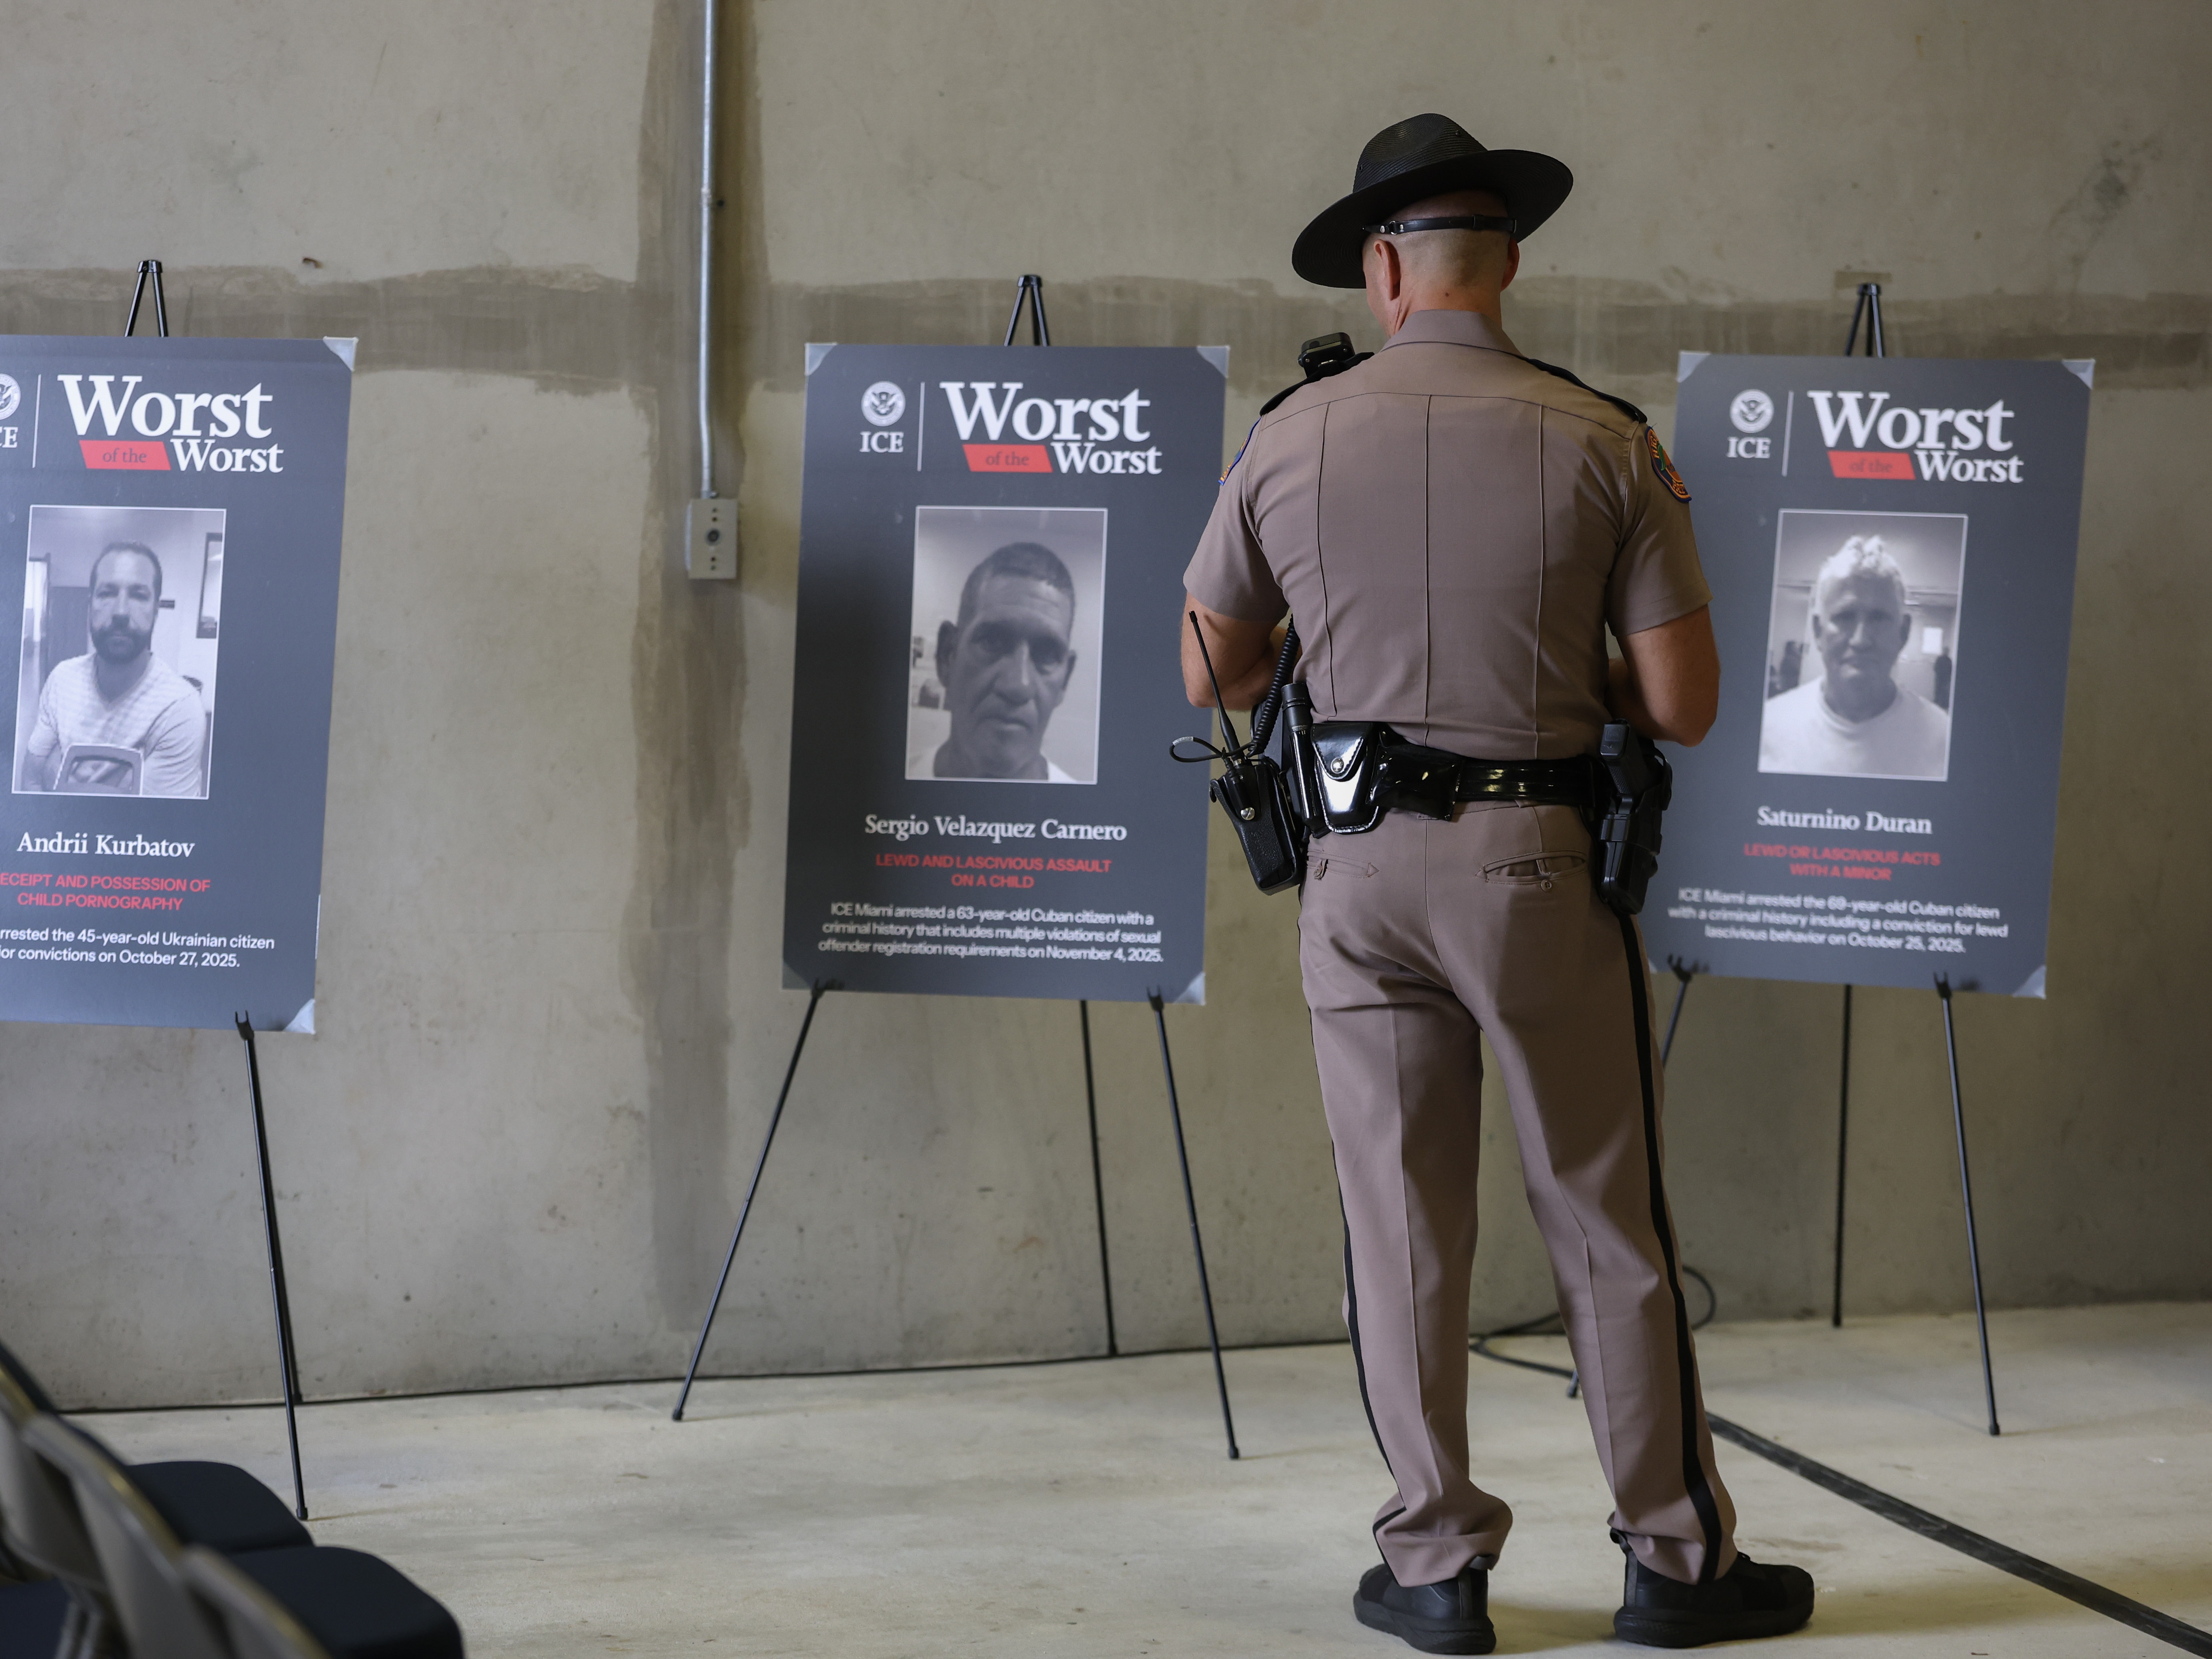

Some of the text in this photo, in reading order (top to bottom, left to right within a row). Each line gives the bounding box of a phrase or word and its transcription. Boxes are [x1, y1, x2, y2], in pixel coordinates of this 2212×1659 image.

[57, 375, 273, 438] Worst
[939, 382, 1150, 442] Worst
[1807, 390, 2014, 452] Worst
[860, 431, 903, 452] ICE
[1728, 437, 1771, 458] ICE
[102, 439, 284, 472] of the Worst
[986, 442, 1162, 474] of the Worst
[1850, 450, 2024, 483] of the Worst
[865, 814, 1127, 844] Sergio Velazquez Carnero
[1757, 806, 1931, 834] Saturnino Duran
[17, 832, 195, 857] Andrii Kurbatov
[1744, 843, 1940, 866] LEWD OR LASCIVIOUS ACTS
[876, 854, 1112, 872] LEWD AND LASCIVIOUS ASSAULT
[1790, 863, 1892, 880] WITH A MINOR
[0, 873, 211, 892] ECEIPT AND POSSESSION OF
[951, 873, 1034, 888] ON A CHILD
[17, 892, 183, 910] CHILD PORNOGRAPHY
[831, 902, 1154, 925] ICE Miami arrested a 63-year-old Cuban citizen with a
[0, 928, 274, 949] rrested the 45-year-old Ukrainian citizen
[823, 921, 1161, 944] criminal history that includes multiple violations of sexual
[18, 947, 96, 961] convictions
[98, 951, 116, 963] on
[119, 949, 178, 966] October
[179, 952, 199, 968] 27,
[201, 953, 240, 967] 2025.
[818, 938, 1163, 962] offender registration requirements on November 4, 2025.
